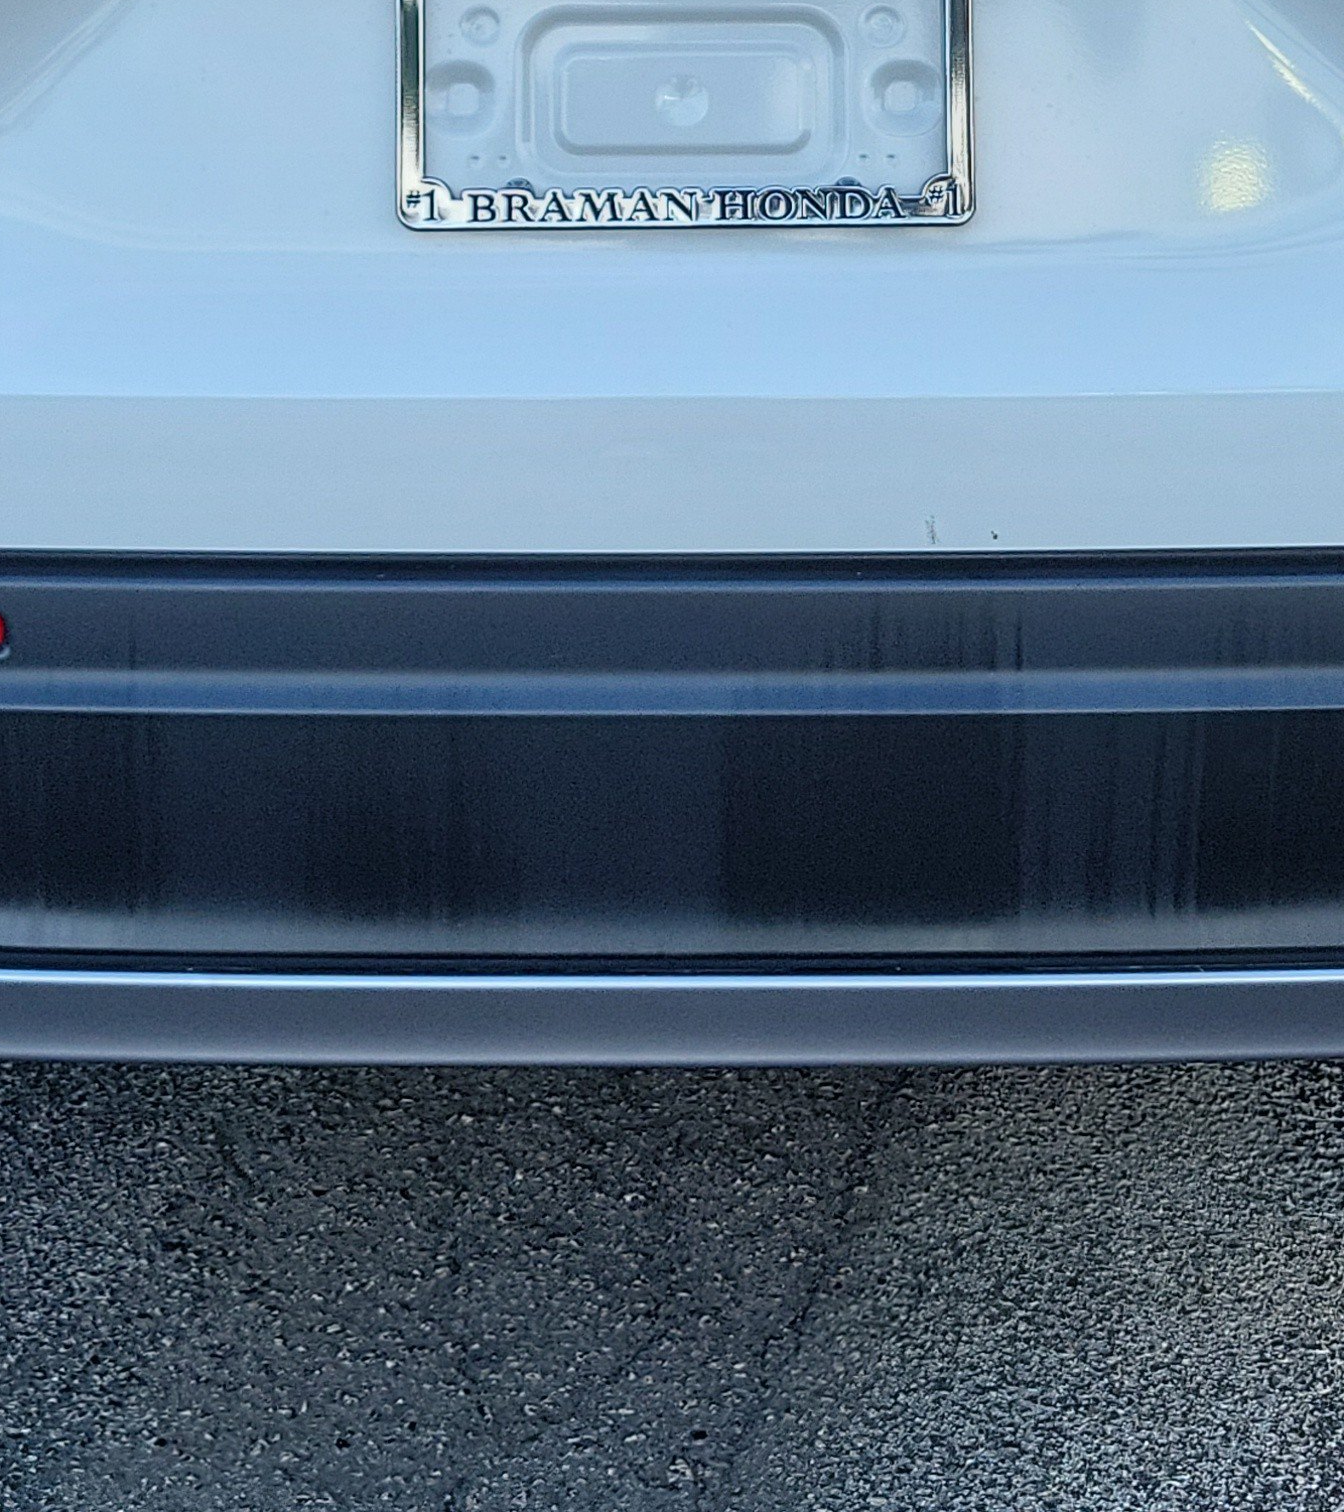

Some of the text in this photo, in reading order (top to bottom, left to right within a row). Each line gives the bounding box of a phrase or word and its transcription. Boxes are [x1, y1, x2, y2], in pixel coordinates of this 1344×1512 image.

[406, 185, 961, 223] #1 BRAMAN HONDA #1
